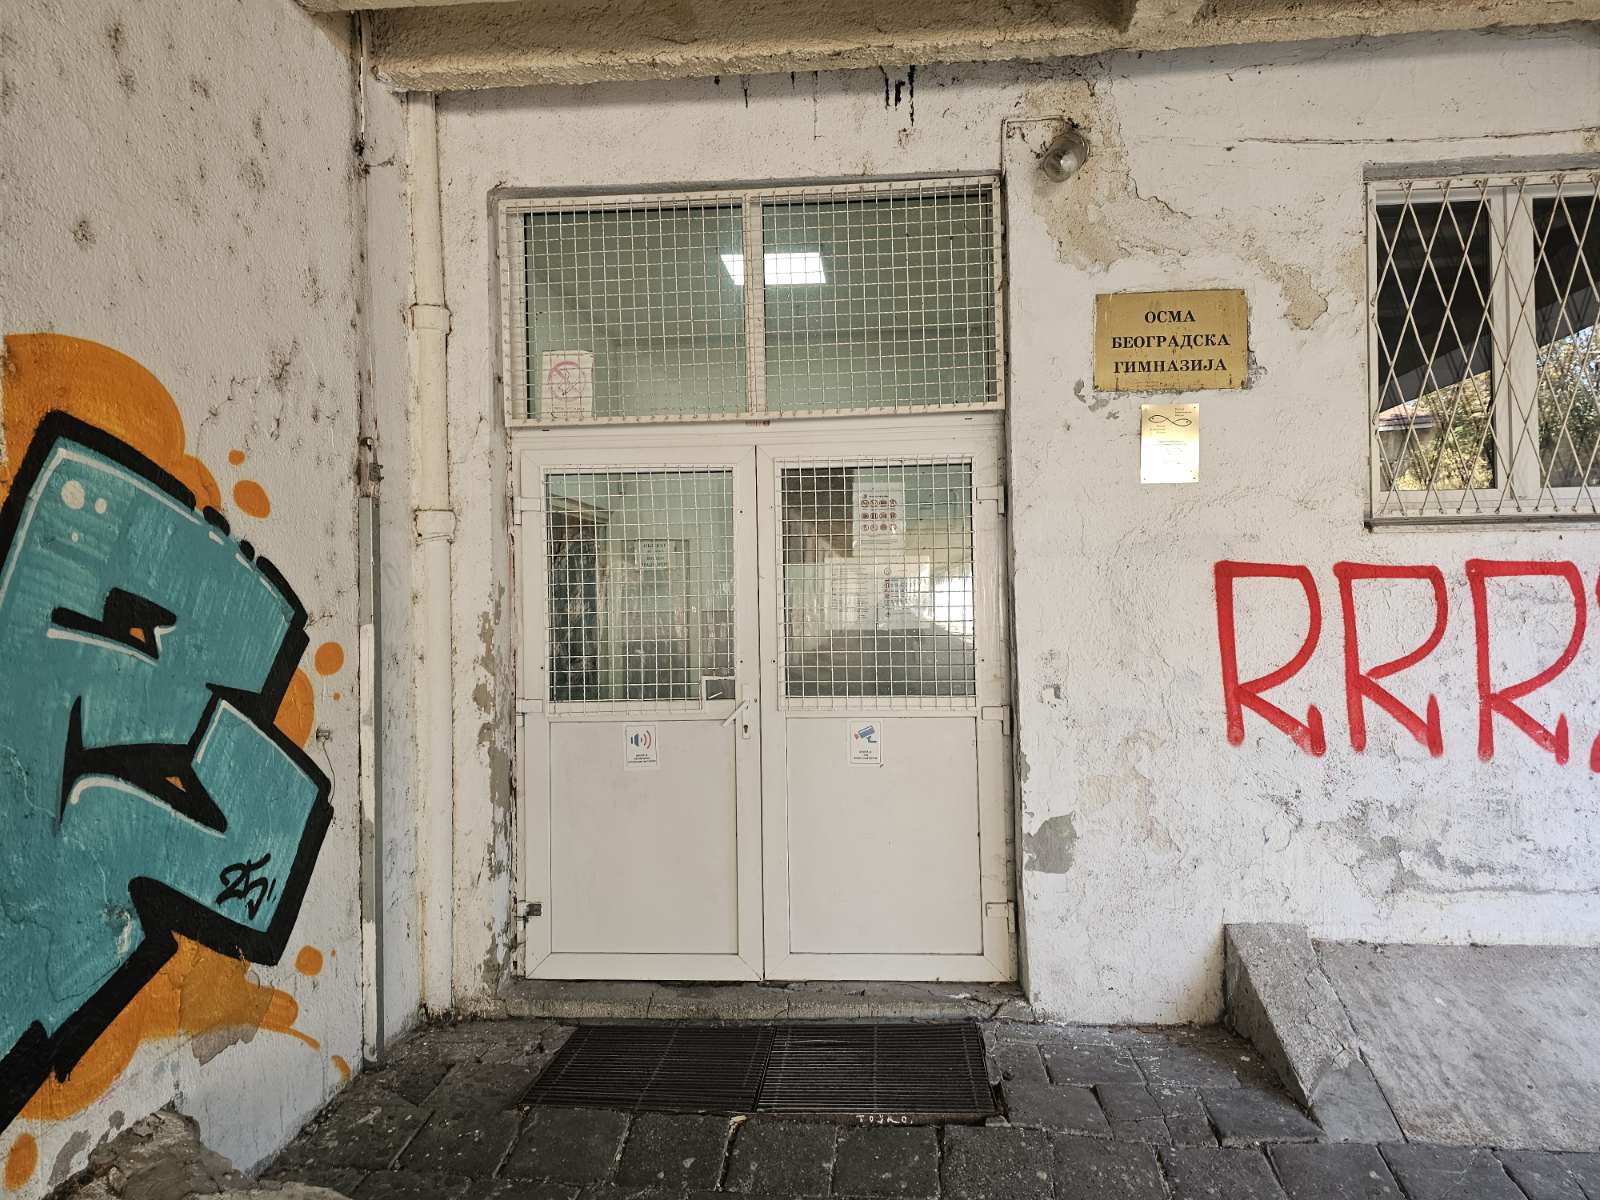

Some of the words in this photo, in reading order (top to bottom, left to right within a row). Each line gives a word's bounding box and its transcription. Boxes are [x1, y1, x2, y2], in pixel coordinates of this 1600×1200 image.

[1144, 310, 1195, 324] ОСМА
[1112, 333, 1231, 349] БЕОГРАДСКА
[1113, 358, 1227, 374] ГИМНАЗИЈА
[1214, 558, 1600, 773] RRR
